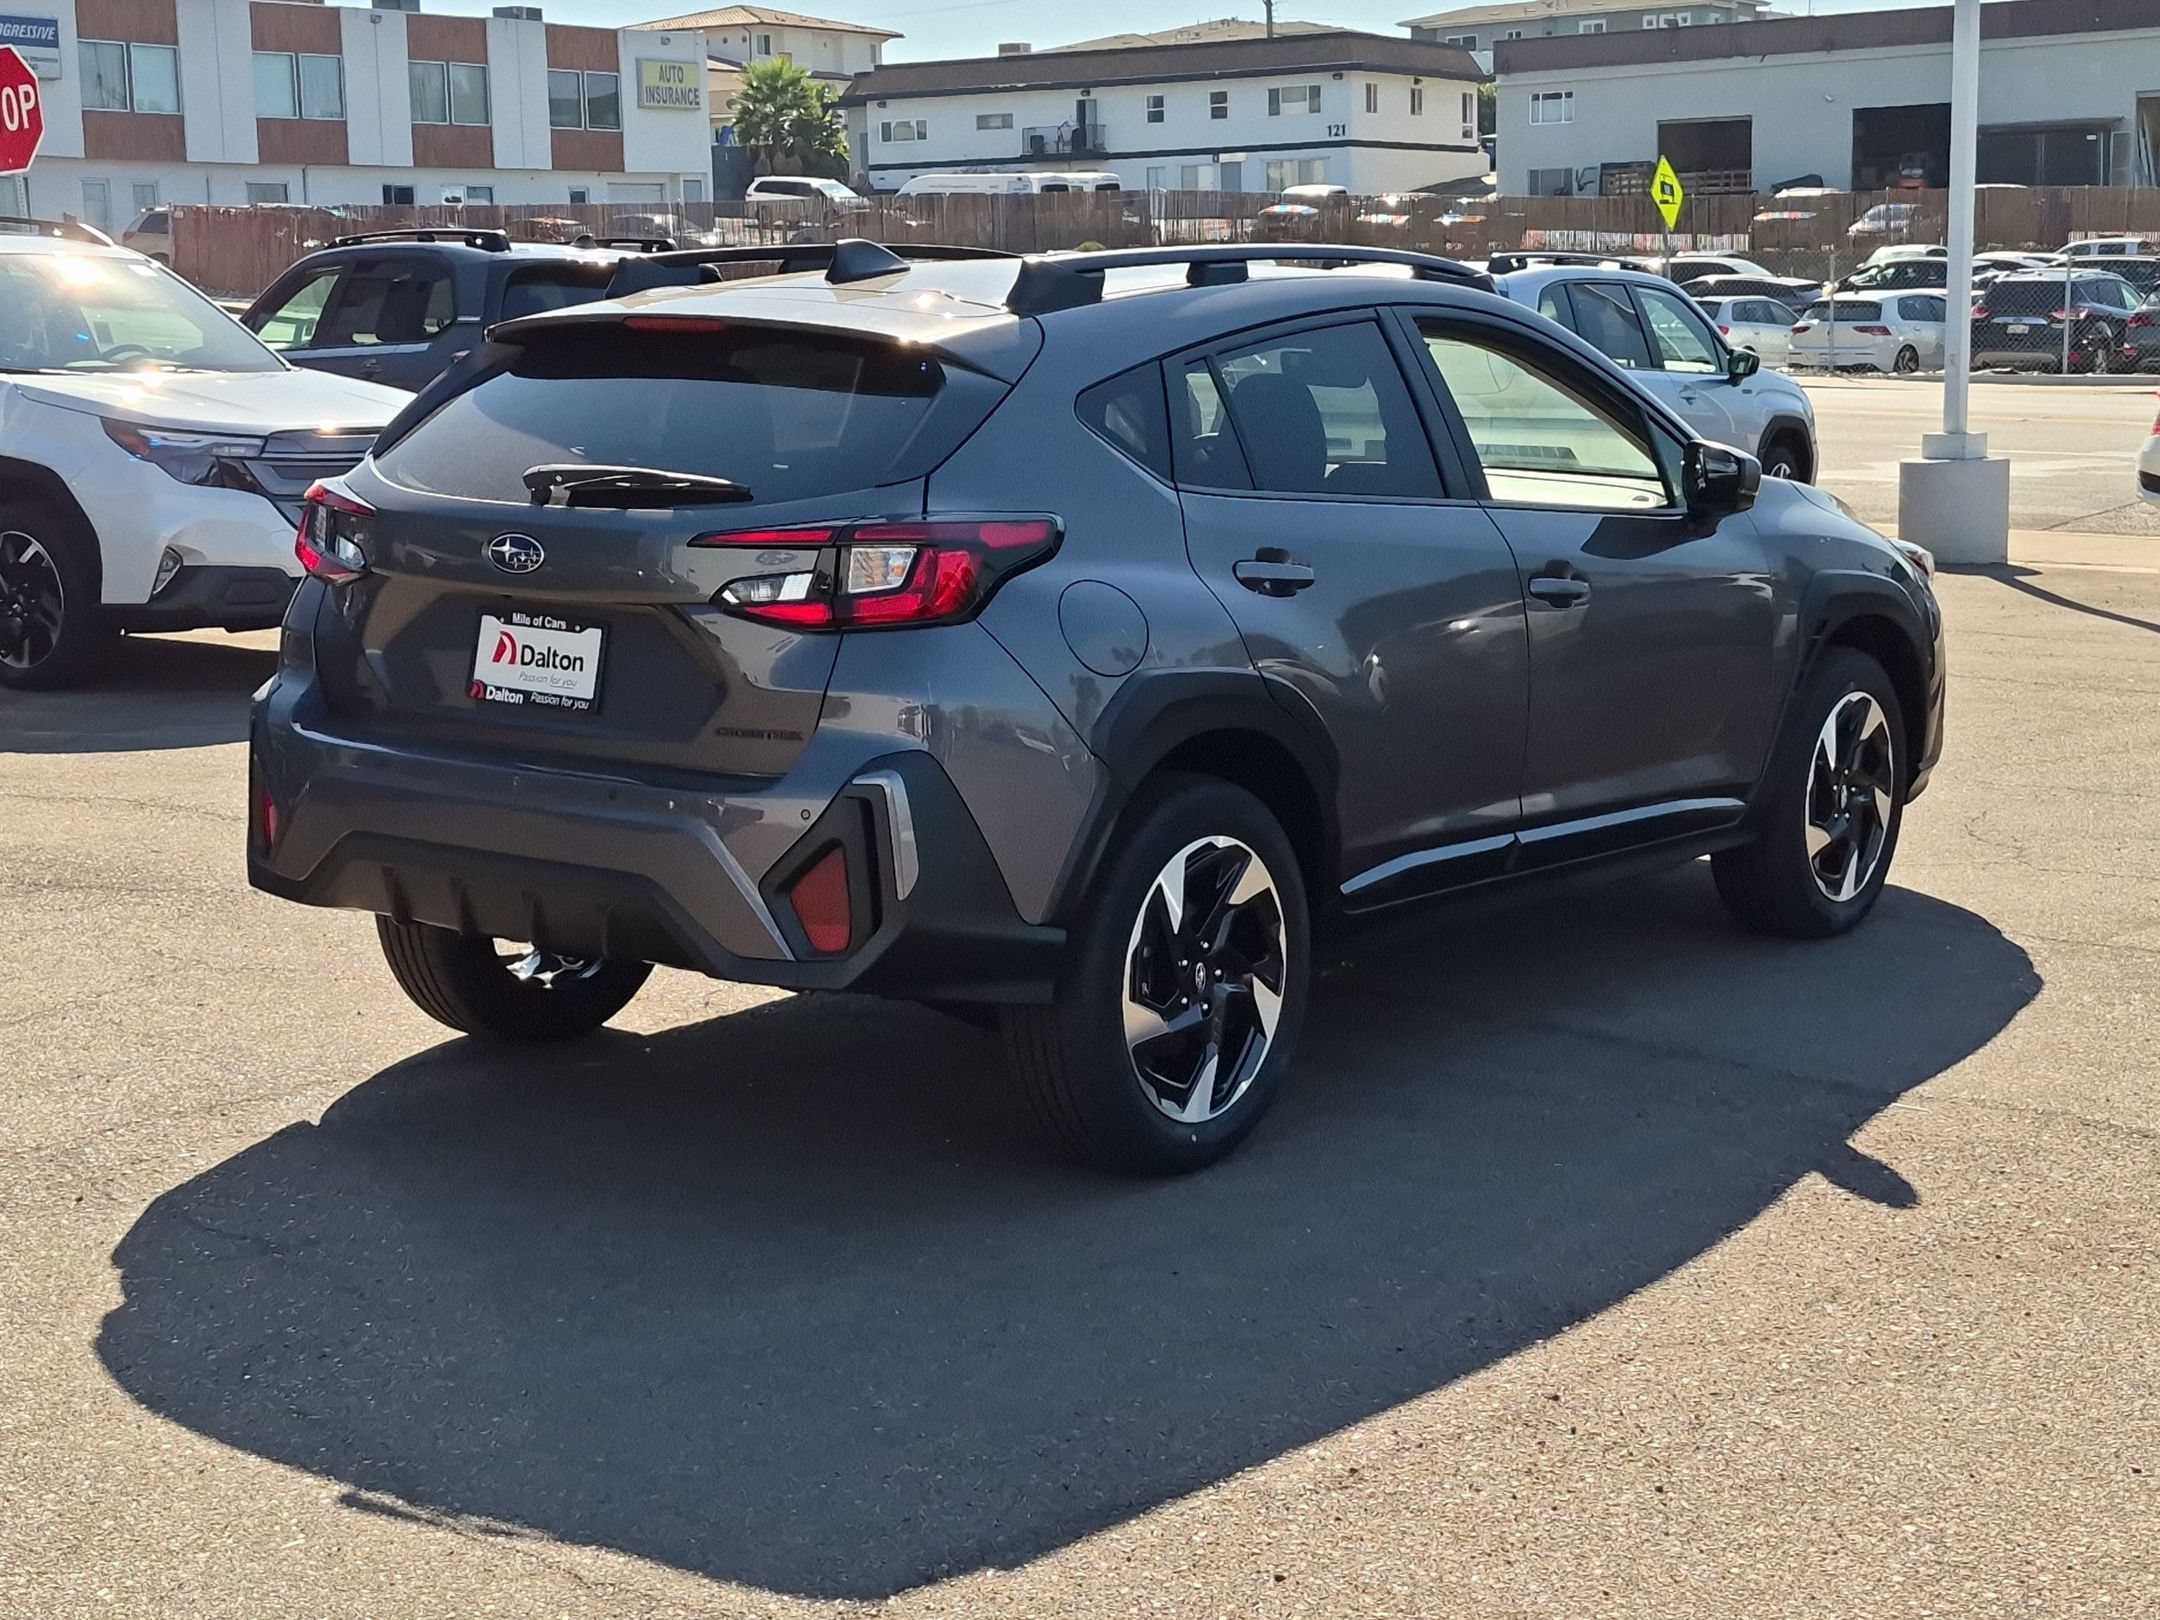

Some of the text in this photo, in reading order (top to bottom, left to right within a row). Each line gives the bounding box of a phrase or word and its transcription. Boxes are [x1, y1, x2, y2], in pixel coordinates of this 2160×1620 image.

[659, 64, 684, 83] AUTO
[645, 85, 700, 106] INSURANCE
[1327, 123, 1346, 137] 121
[512, 612, 567, 630] Mile of Cars
[520, 644, 584, 672] Dalton
[519, 671, 548, 682] Passion
[562, 678, 578, 688] you
[486, 685, 590, 710] Dalton Passion for you
